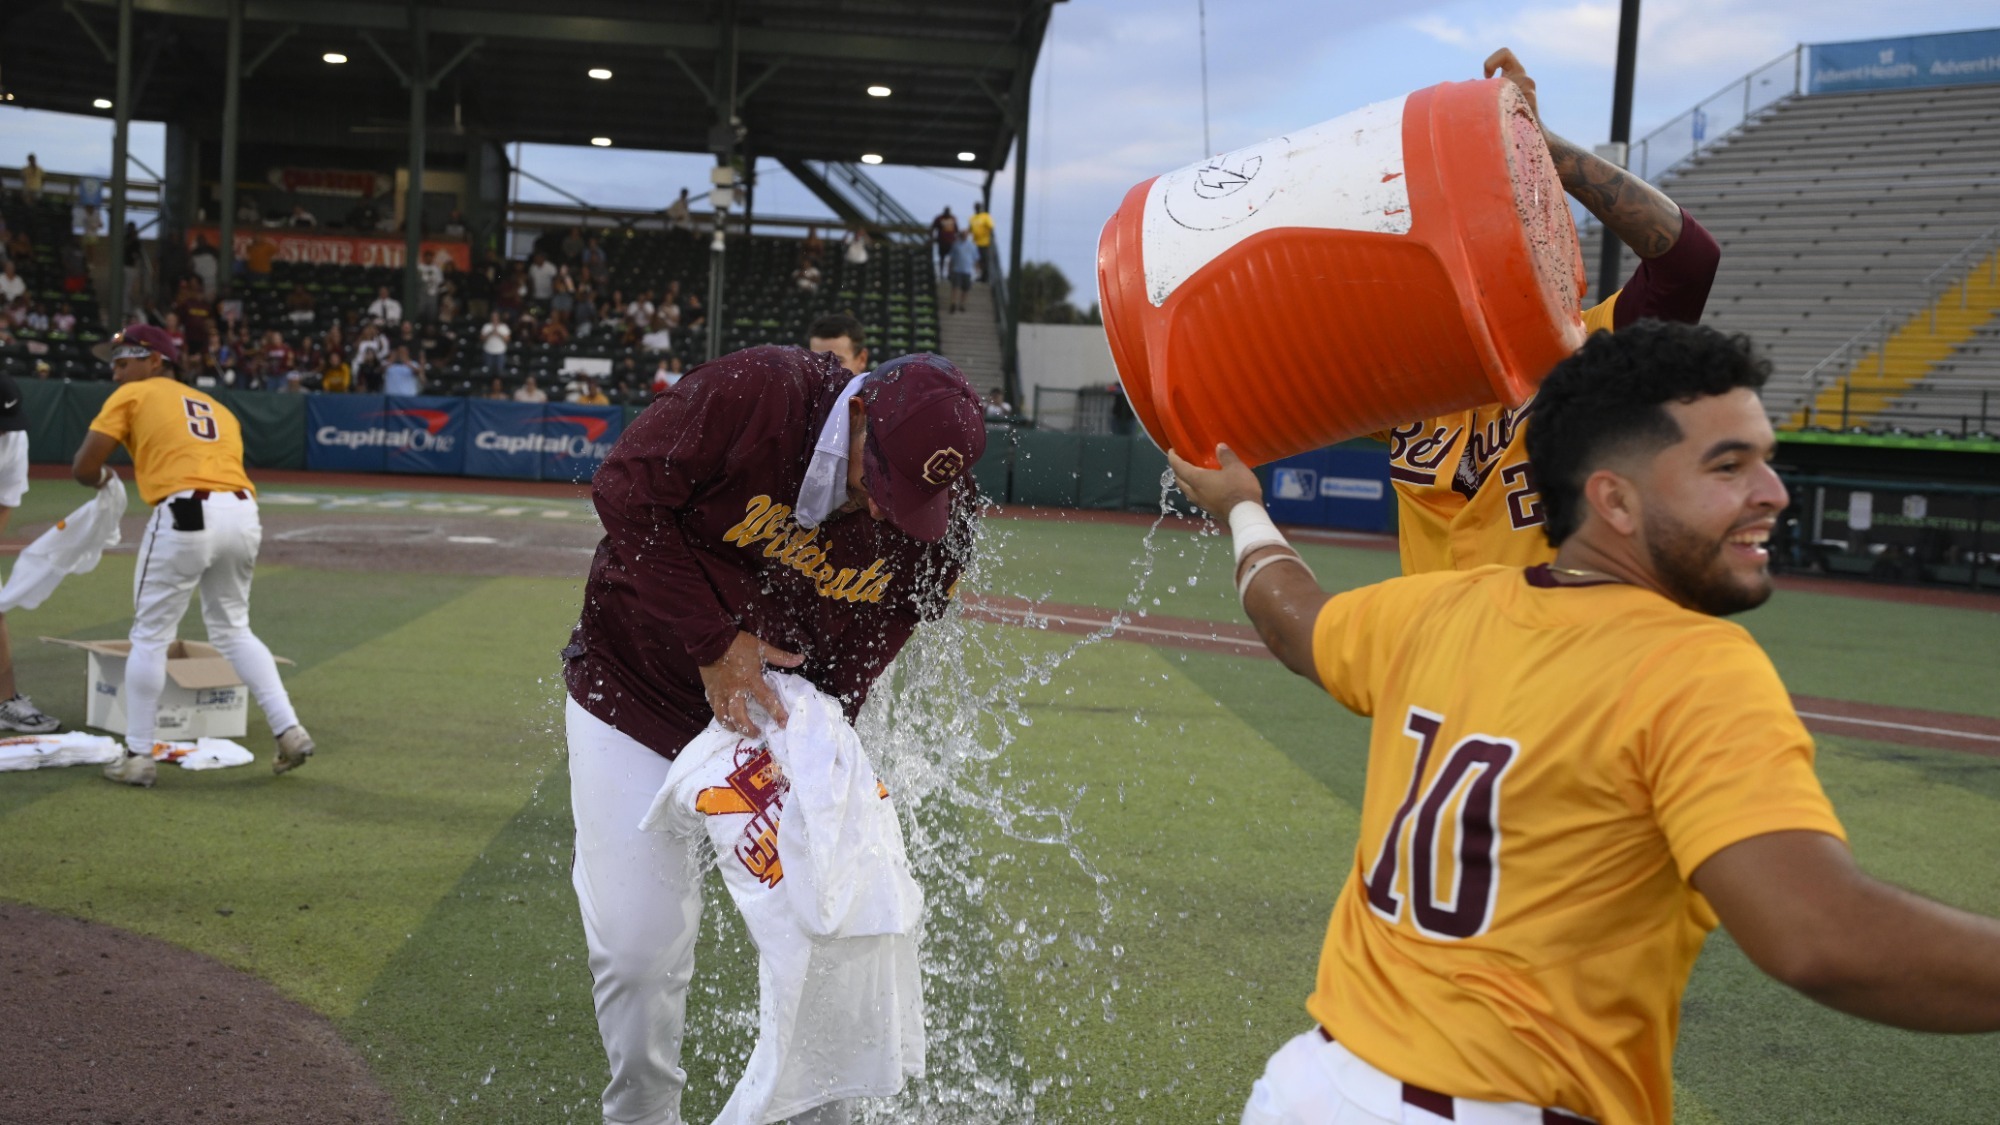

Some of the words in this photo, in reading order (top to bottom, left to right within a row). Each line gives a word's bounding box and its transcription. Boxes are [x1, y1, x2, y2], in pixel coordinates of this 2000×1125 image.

[1815, 63, 1917, 83] AdventHealth
[1930, 56, 2000, 75] AdventH
[182, 395, 220, 442] 5
[735, 790, 789, 877] CHA
[1362, 706, 1521, 941] 10
